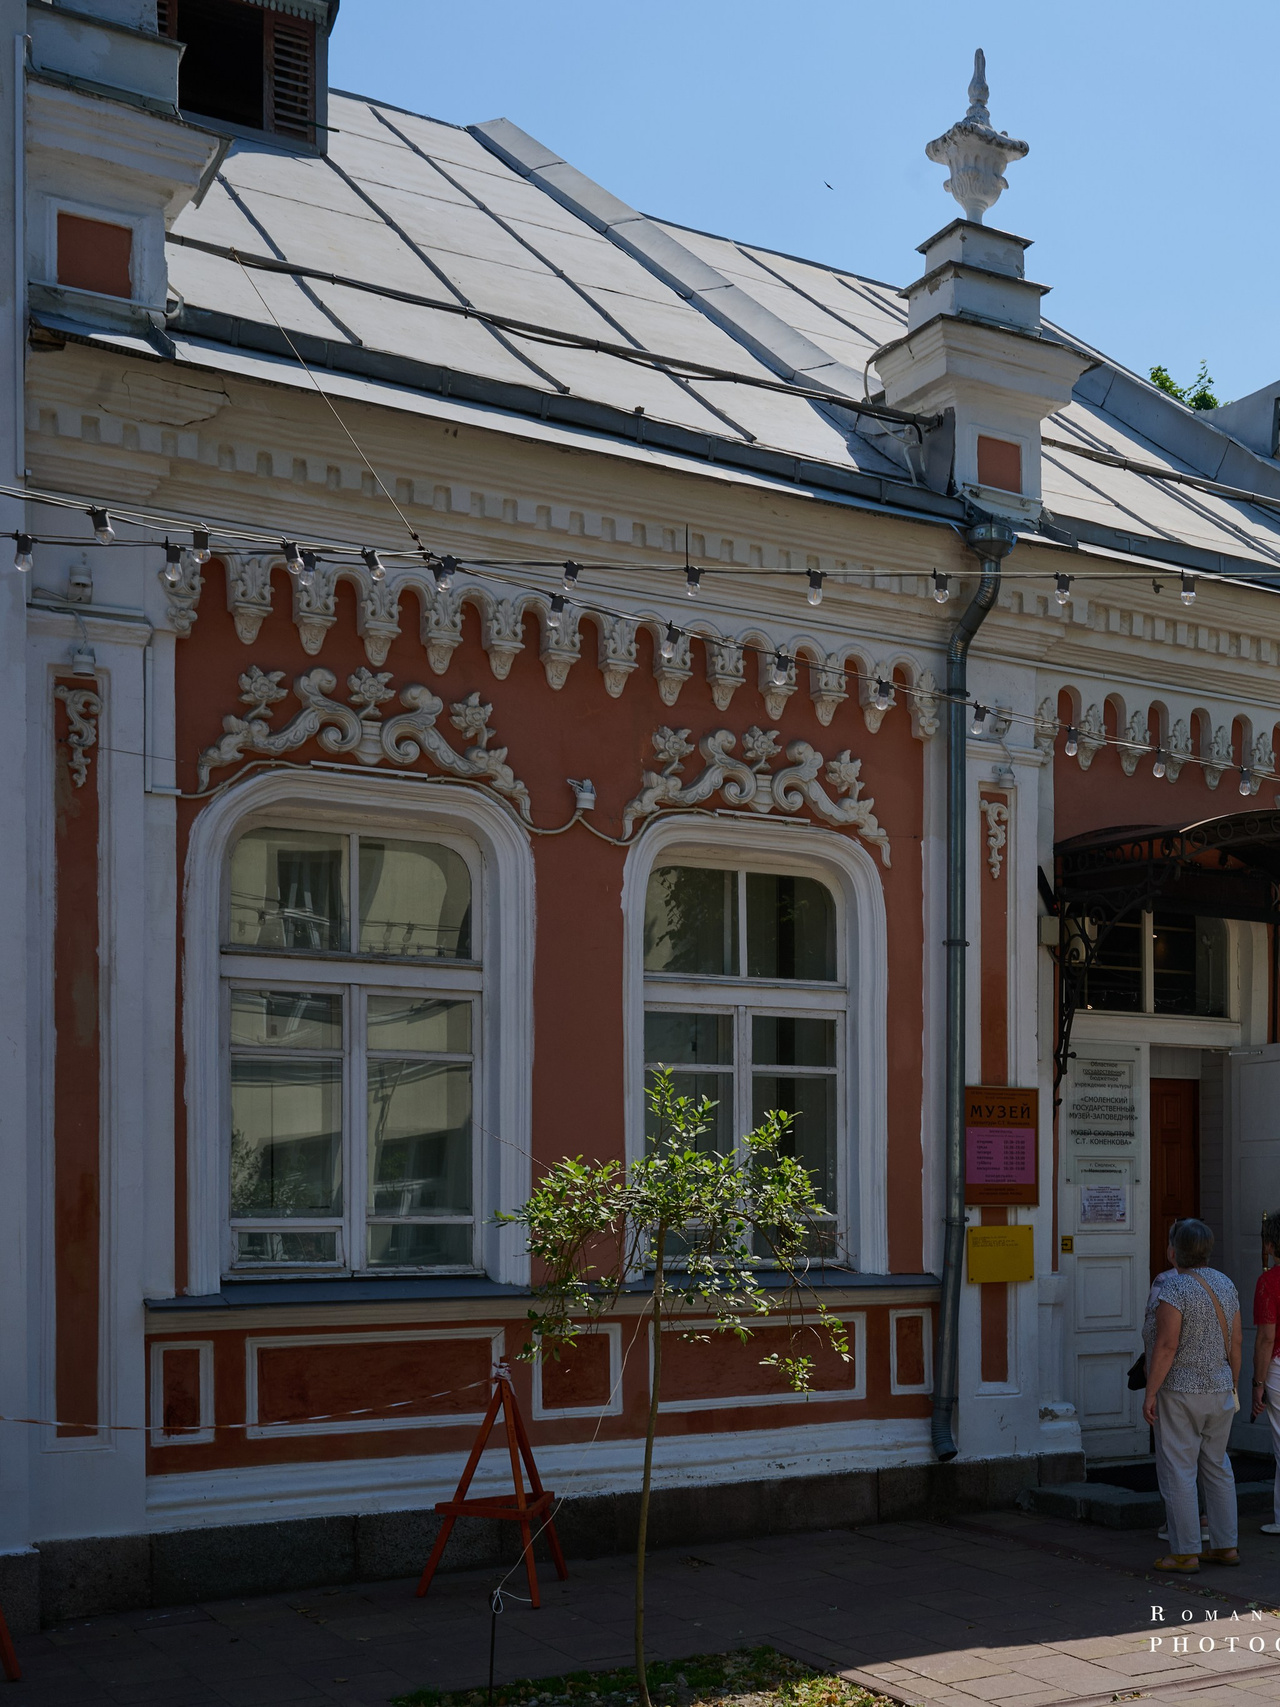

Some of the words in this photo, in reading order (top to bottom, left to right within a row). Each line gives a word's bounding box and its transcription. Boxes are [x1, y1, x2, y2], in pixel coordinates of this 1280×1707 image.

[1081, 1095, 1128, 1104] «СМОЛЕНСКИЙ
[970, 1103, 1030, 1119] МУЗЕЙ
[1072, 1104, 1135, 1113] ГОСУДАРСТВЕННЫЙ
